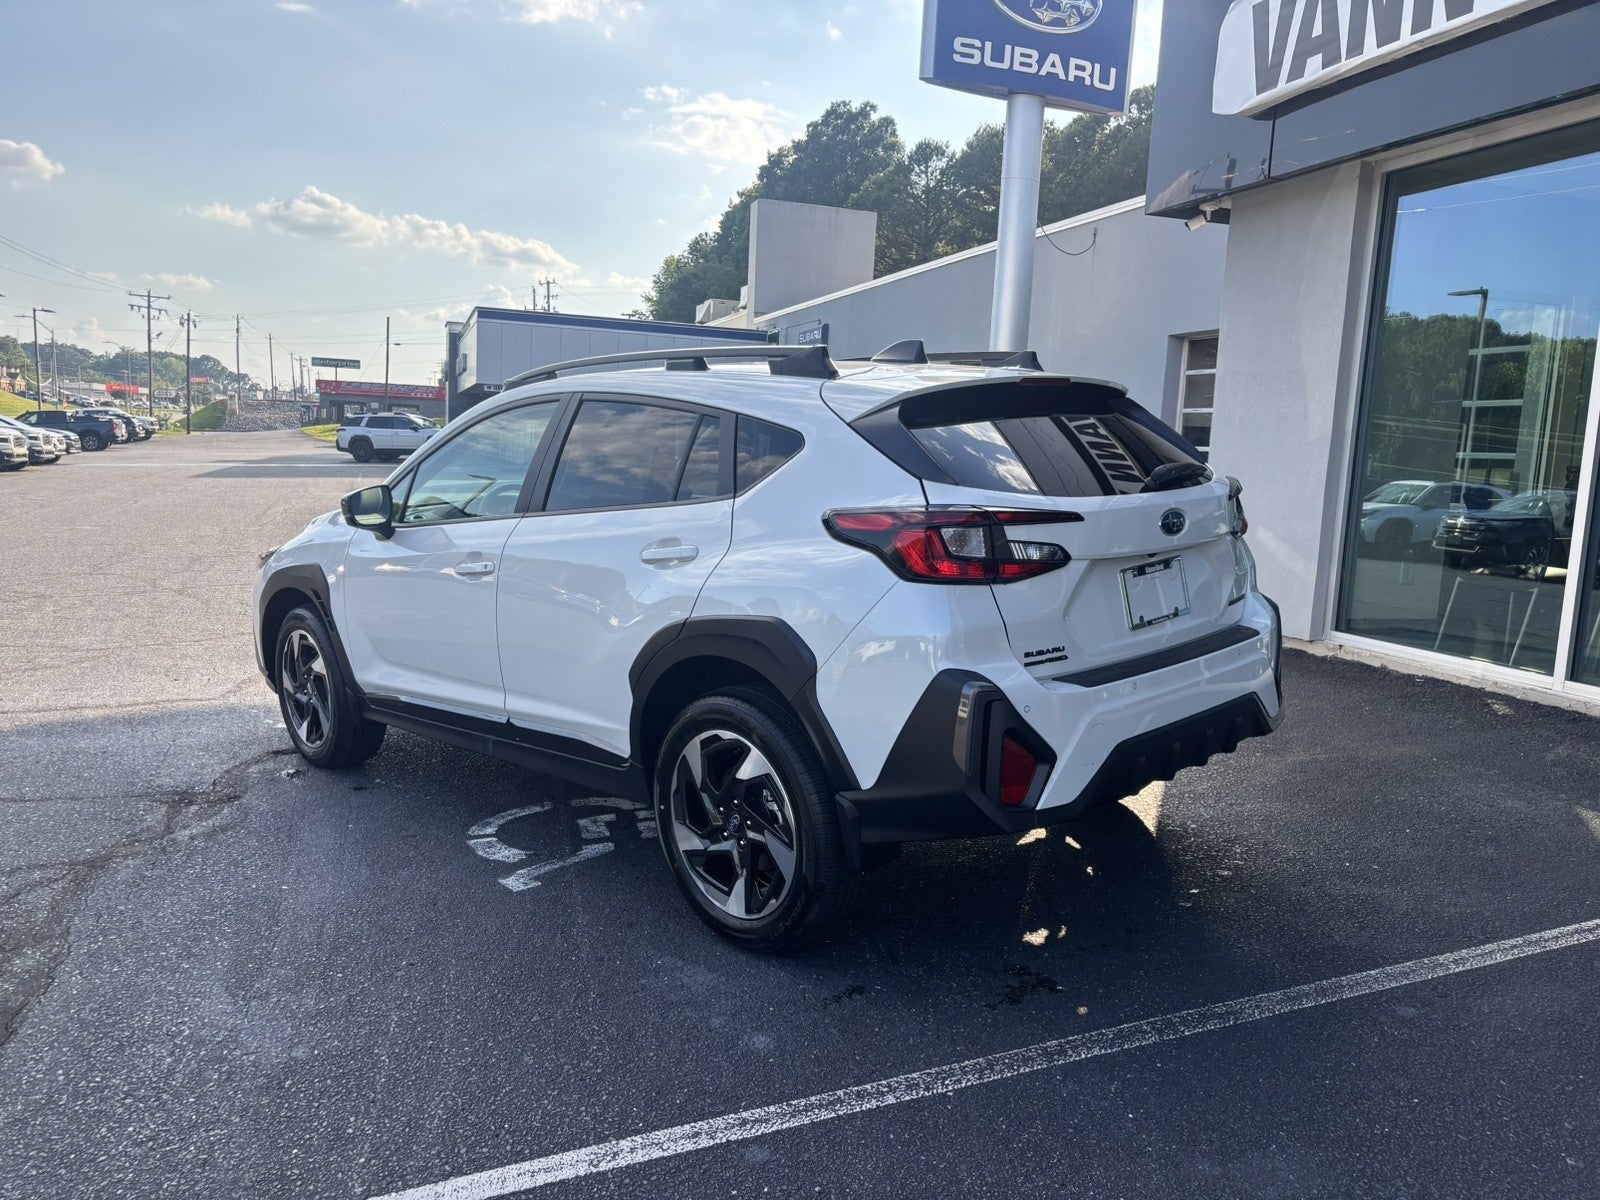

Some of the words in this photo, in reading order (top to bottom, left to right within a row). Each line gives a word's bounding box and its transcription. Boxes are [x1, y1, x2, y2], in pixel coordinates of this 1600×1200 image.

[952, 36, 1117, 92] SUBARU
[799, 329, 822, 343] SUBARU
[313, 358, 360, 368] enterprise
[1024, 645, 1066, 658] SUBARU
